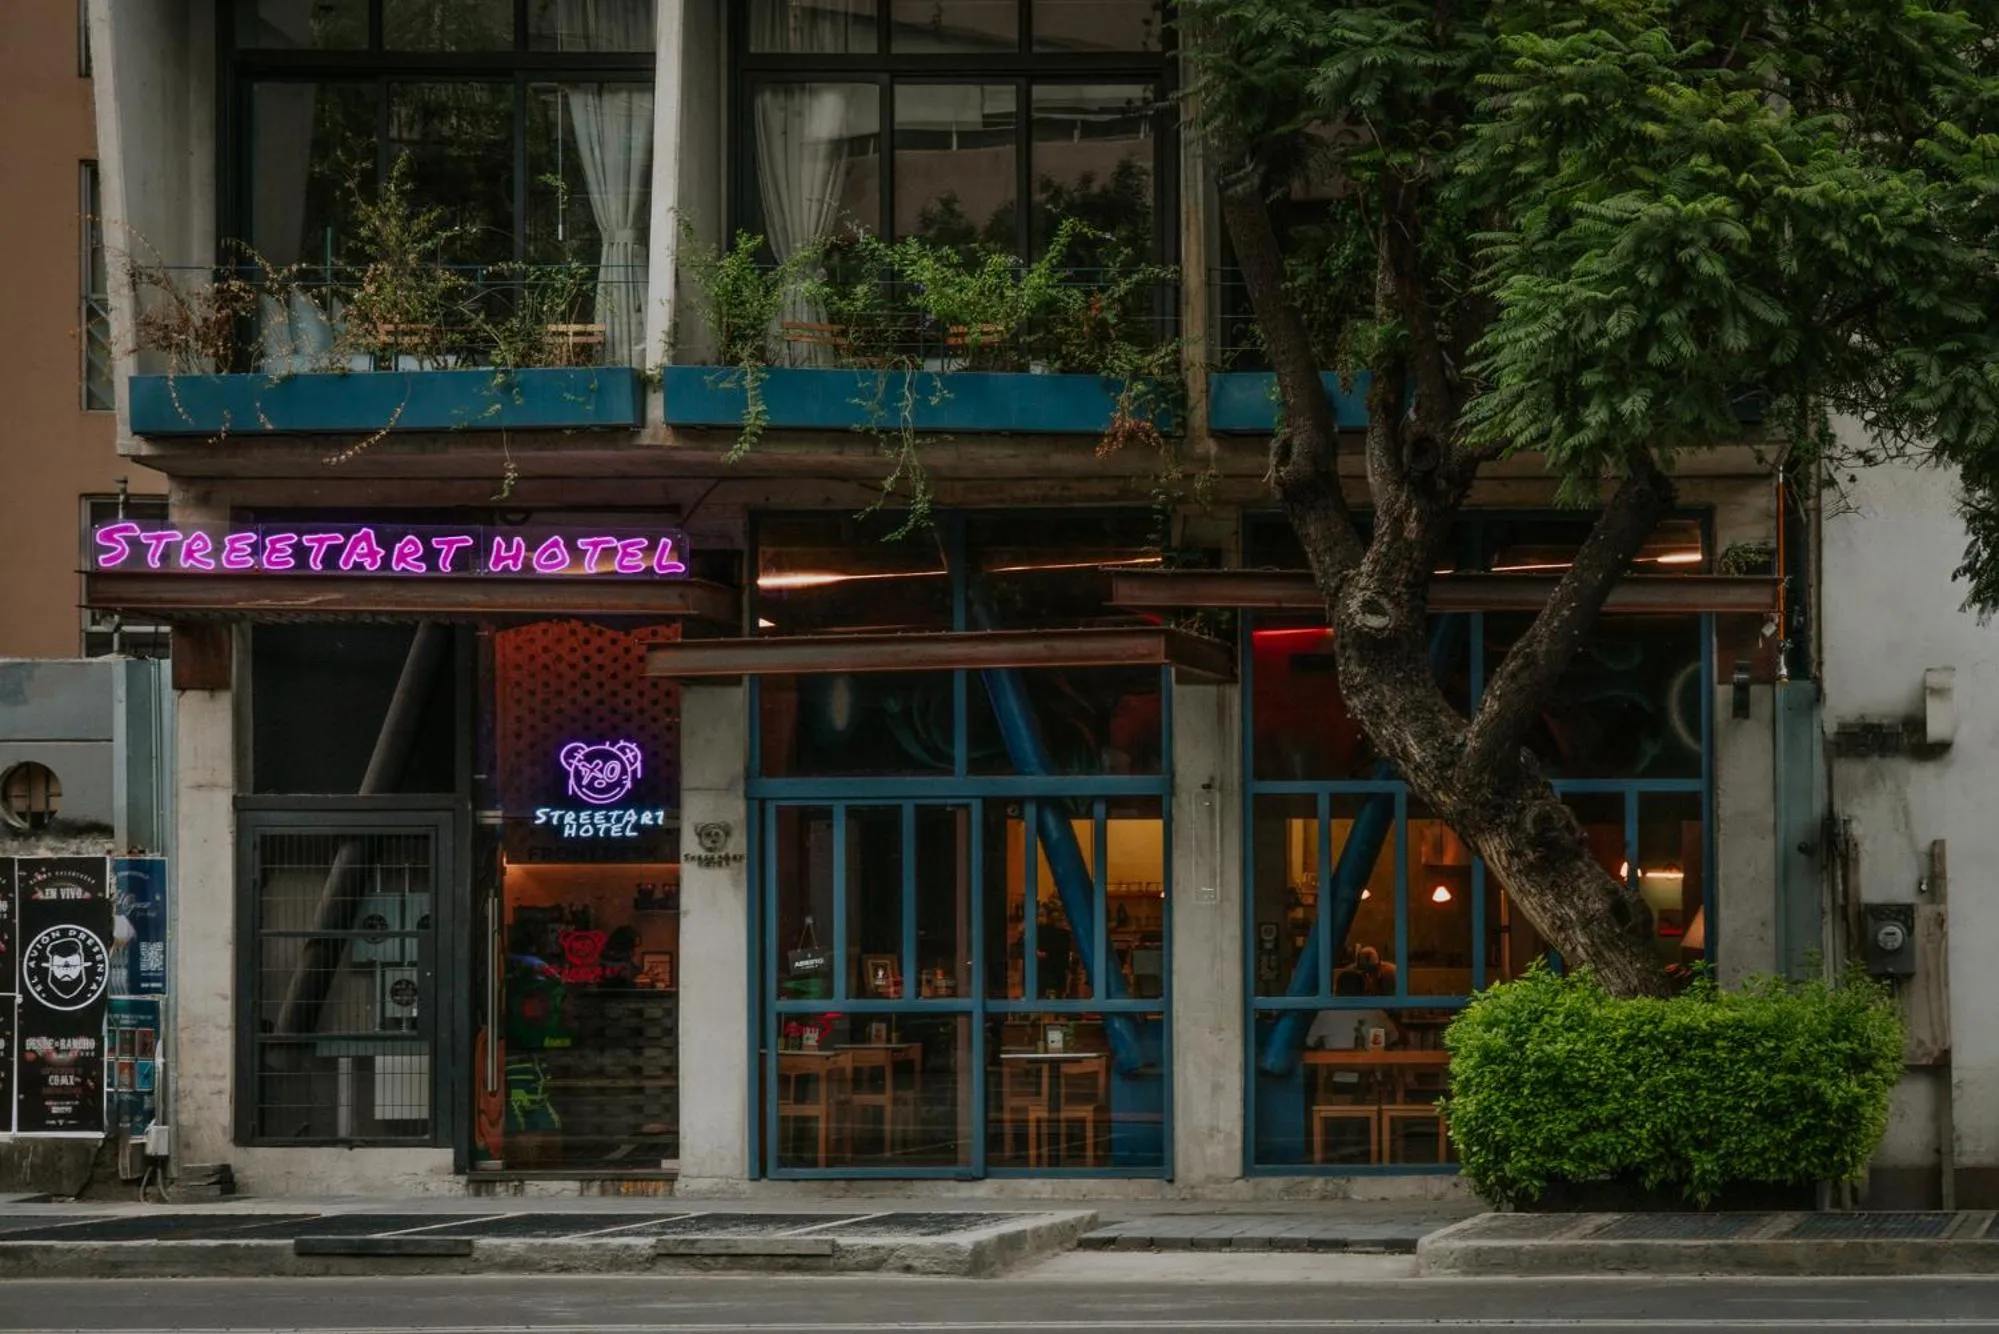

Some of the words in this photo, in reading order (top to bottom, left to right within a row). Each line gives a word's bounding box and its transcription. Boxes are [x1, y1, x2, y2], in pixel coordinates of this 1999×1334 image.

[95, 521, 472, 571] STREETART
[489, 534, 687, 573] HOTEL
[534, 807, 664, 825] STREETART
[563, 823, 640, 838] HOTEL
[44, 887, 57, 899] EN
[59, 887, 83, 900] VIVO
[68, 929, 105, 991] PRESENTA
